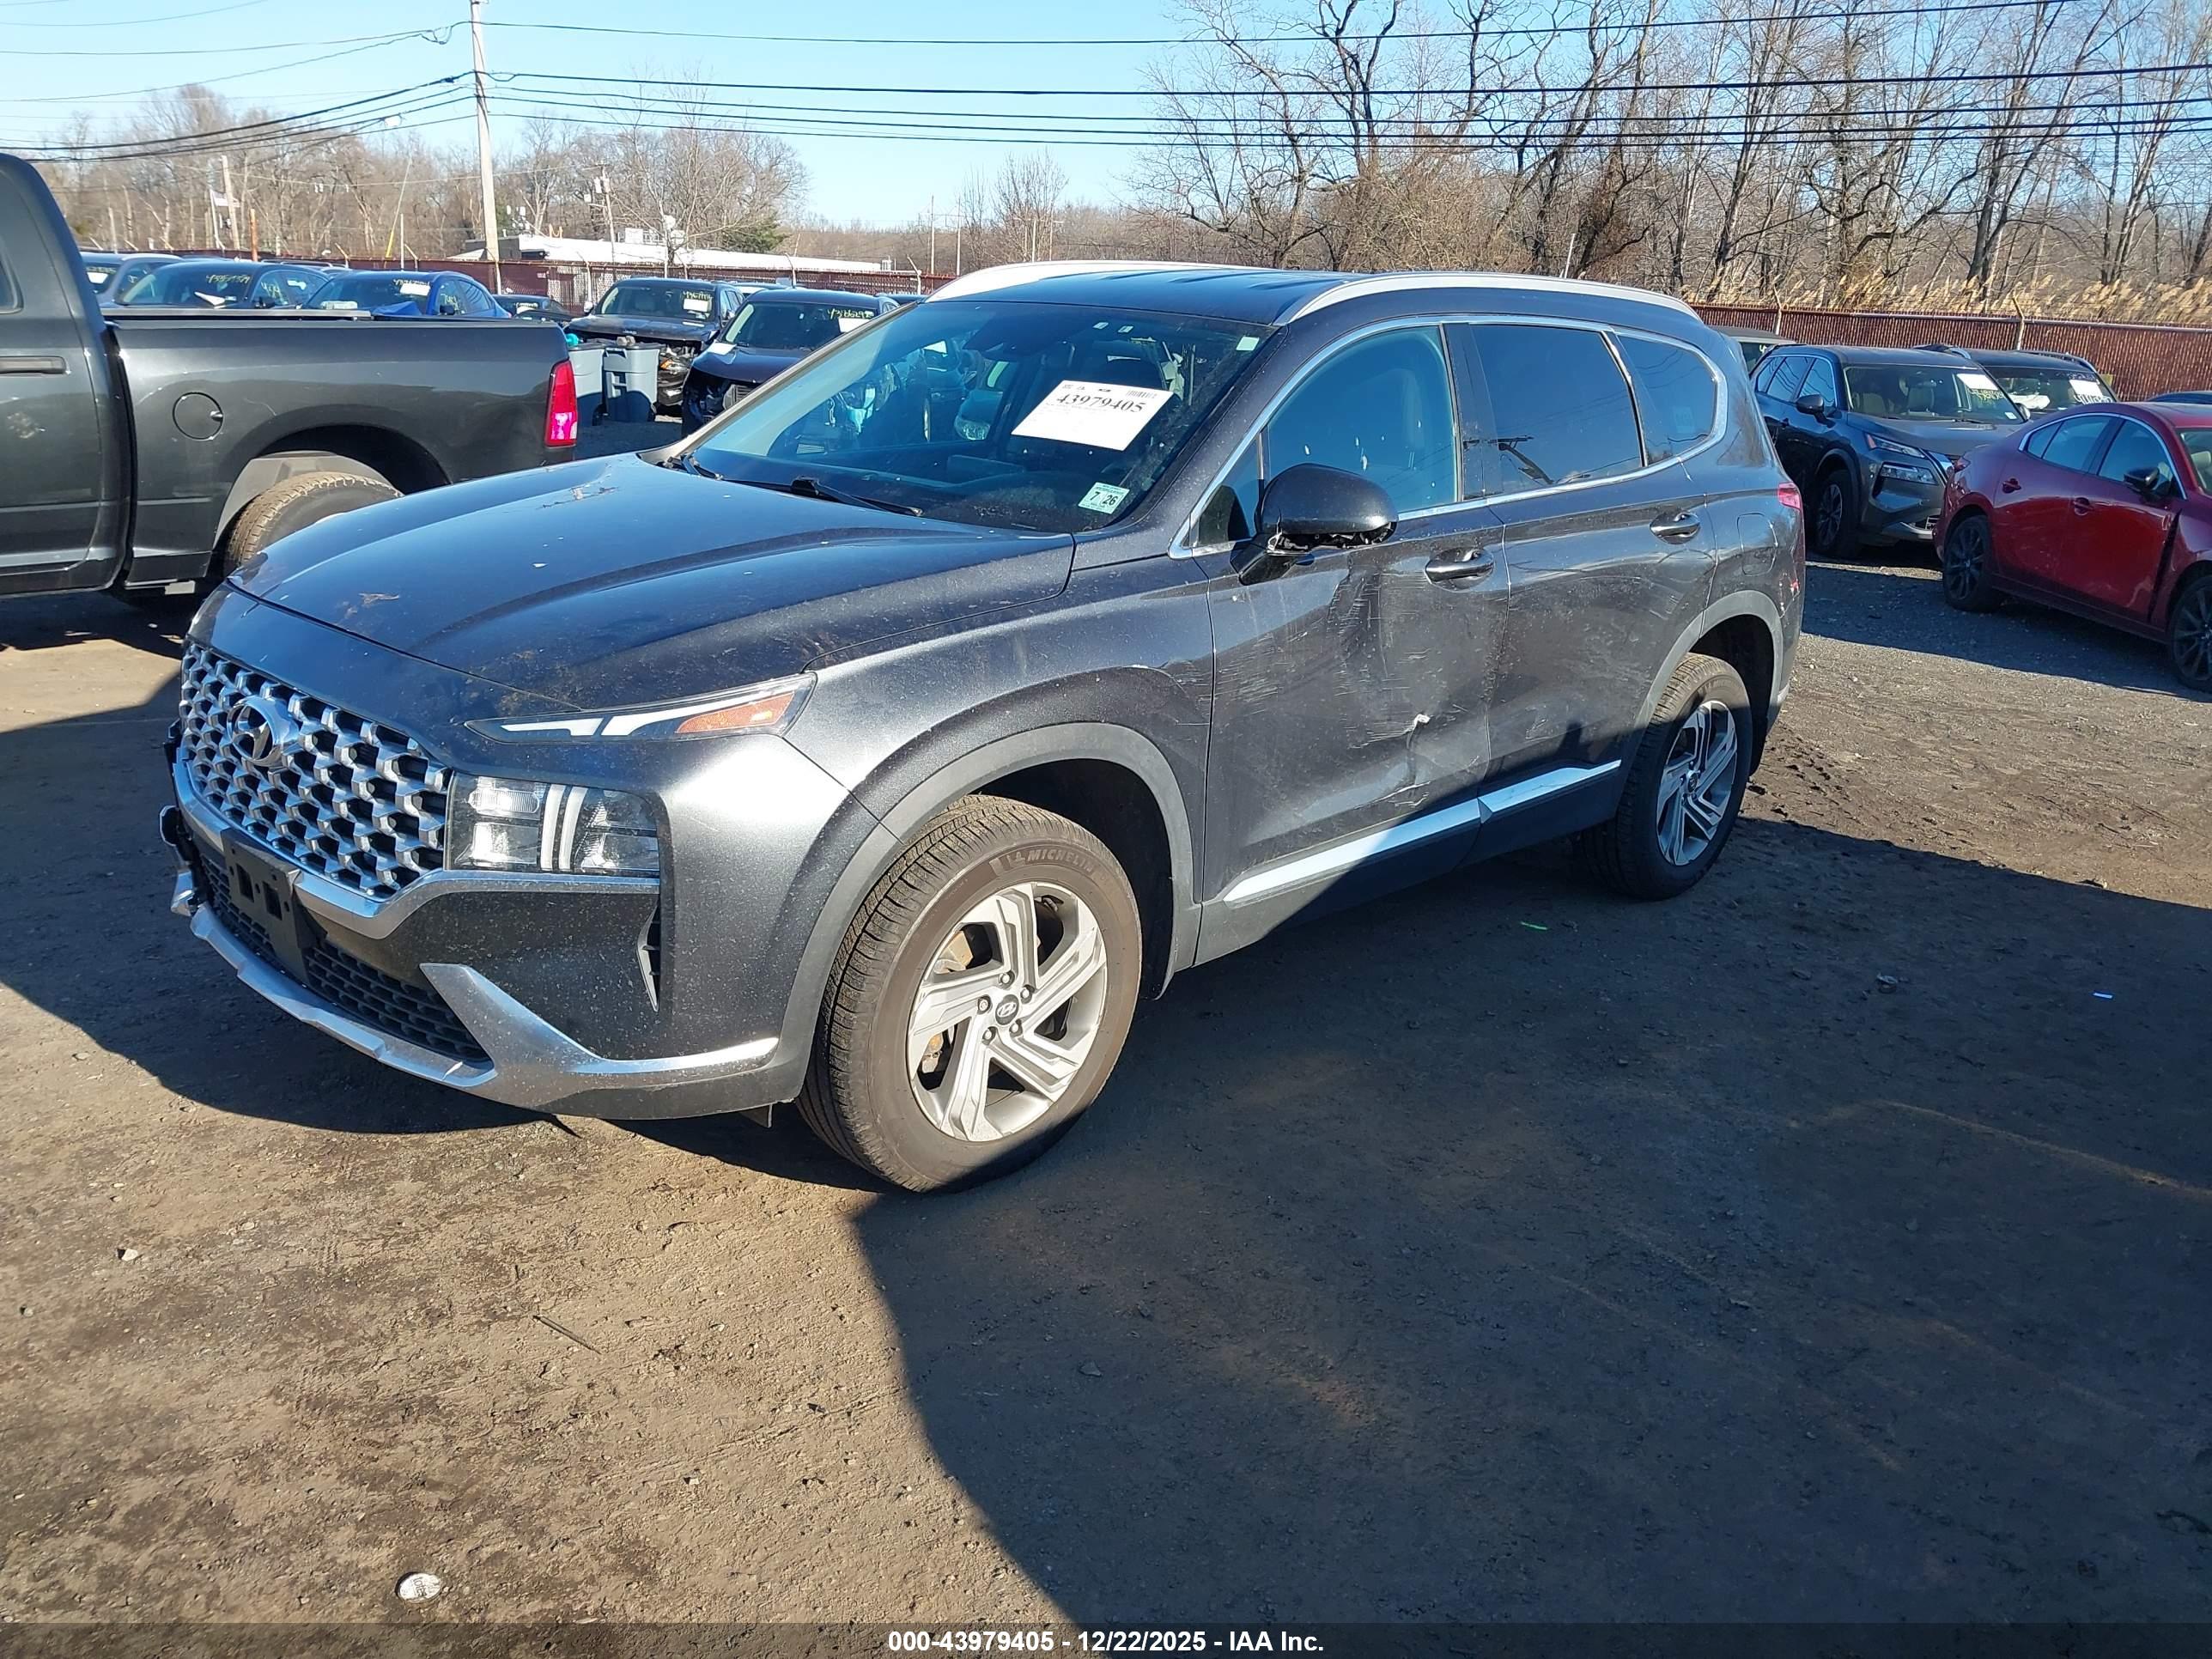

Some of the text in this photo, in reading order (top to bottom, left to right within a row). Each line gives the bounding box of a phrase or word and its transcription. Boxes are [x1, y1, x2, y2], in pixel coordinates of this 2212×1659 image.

[1057, 393, 1146, 412] 43979405
[1090, 491, 1118, 505] 7 26
[1027, 849, 1093, 872] MICHELIN
